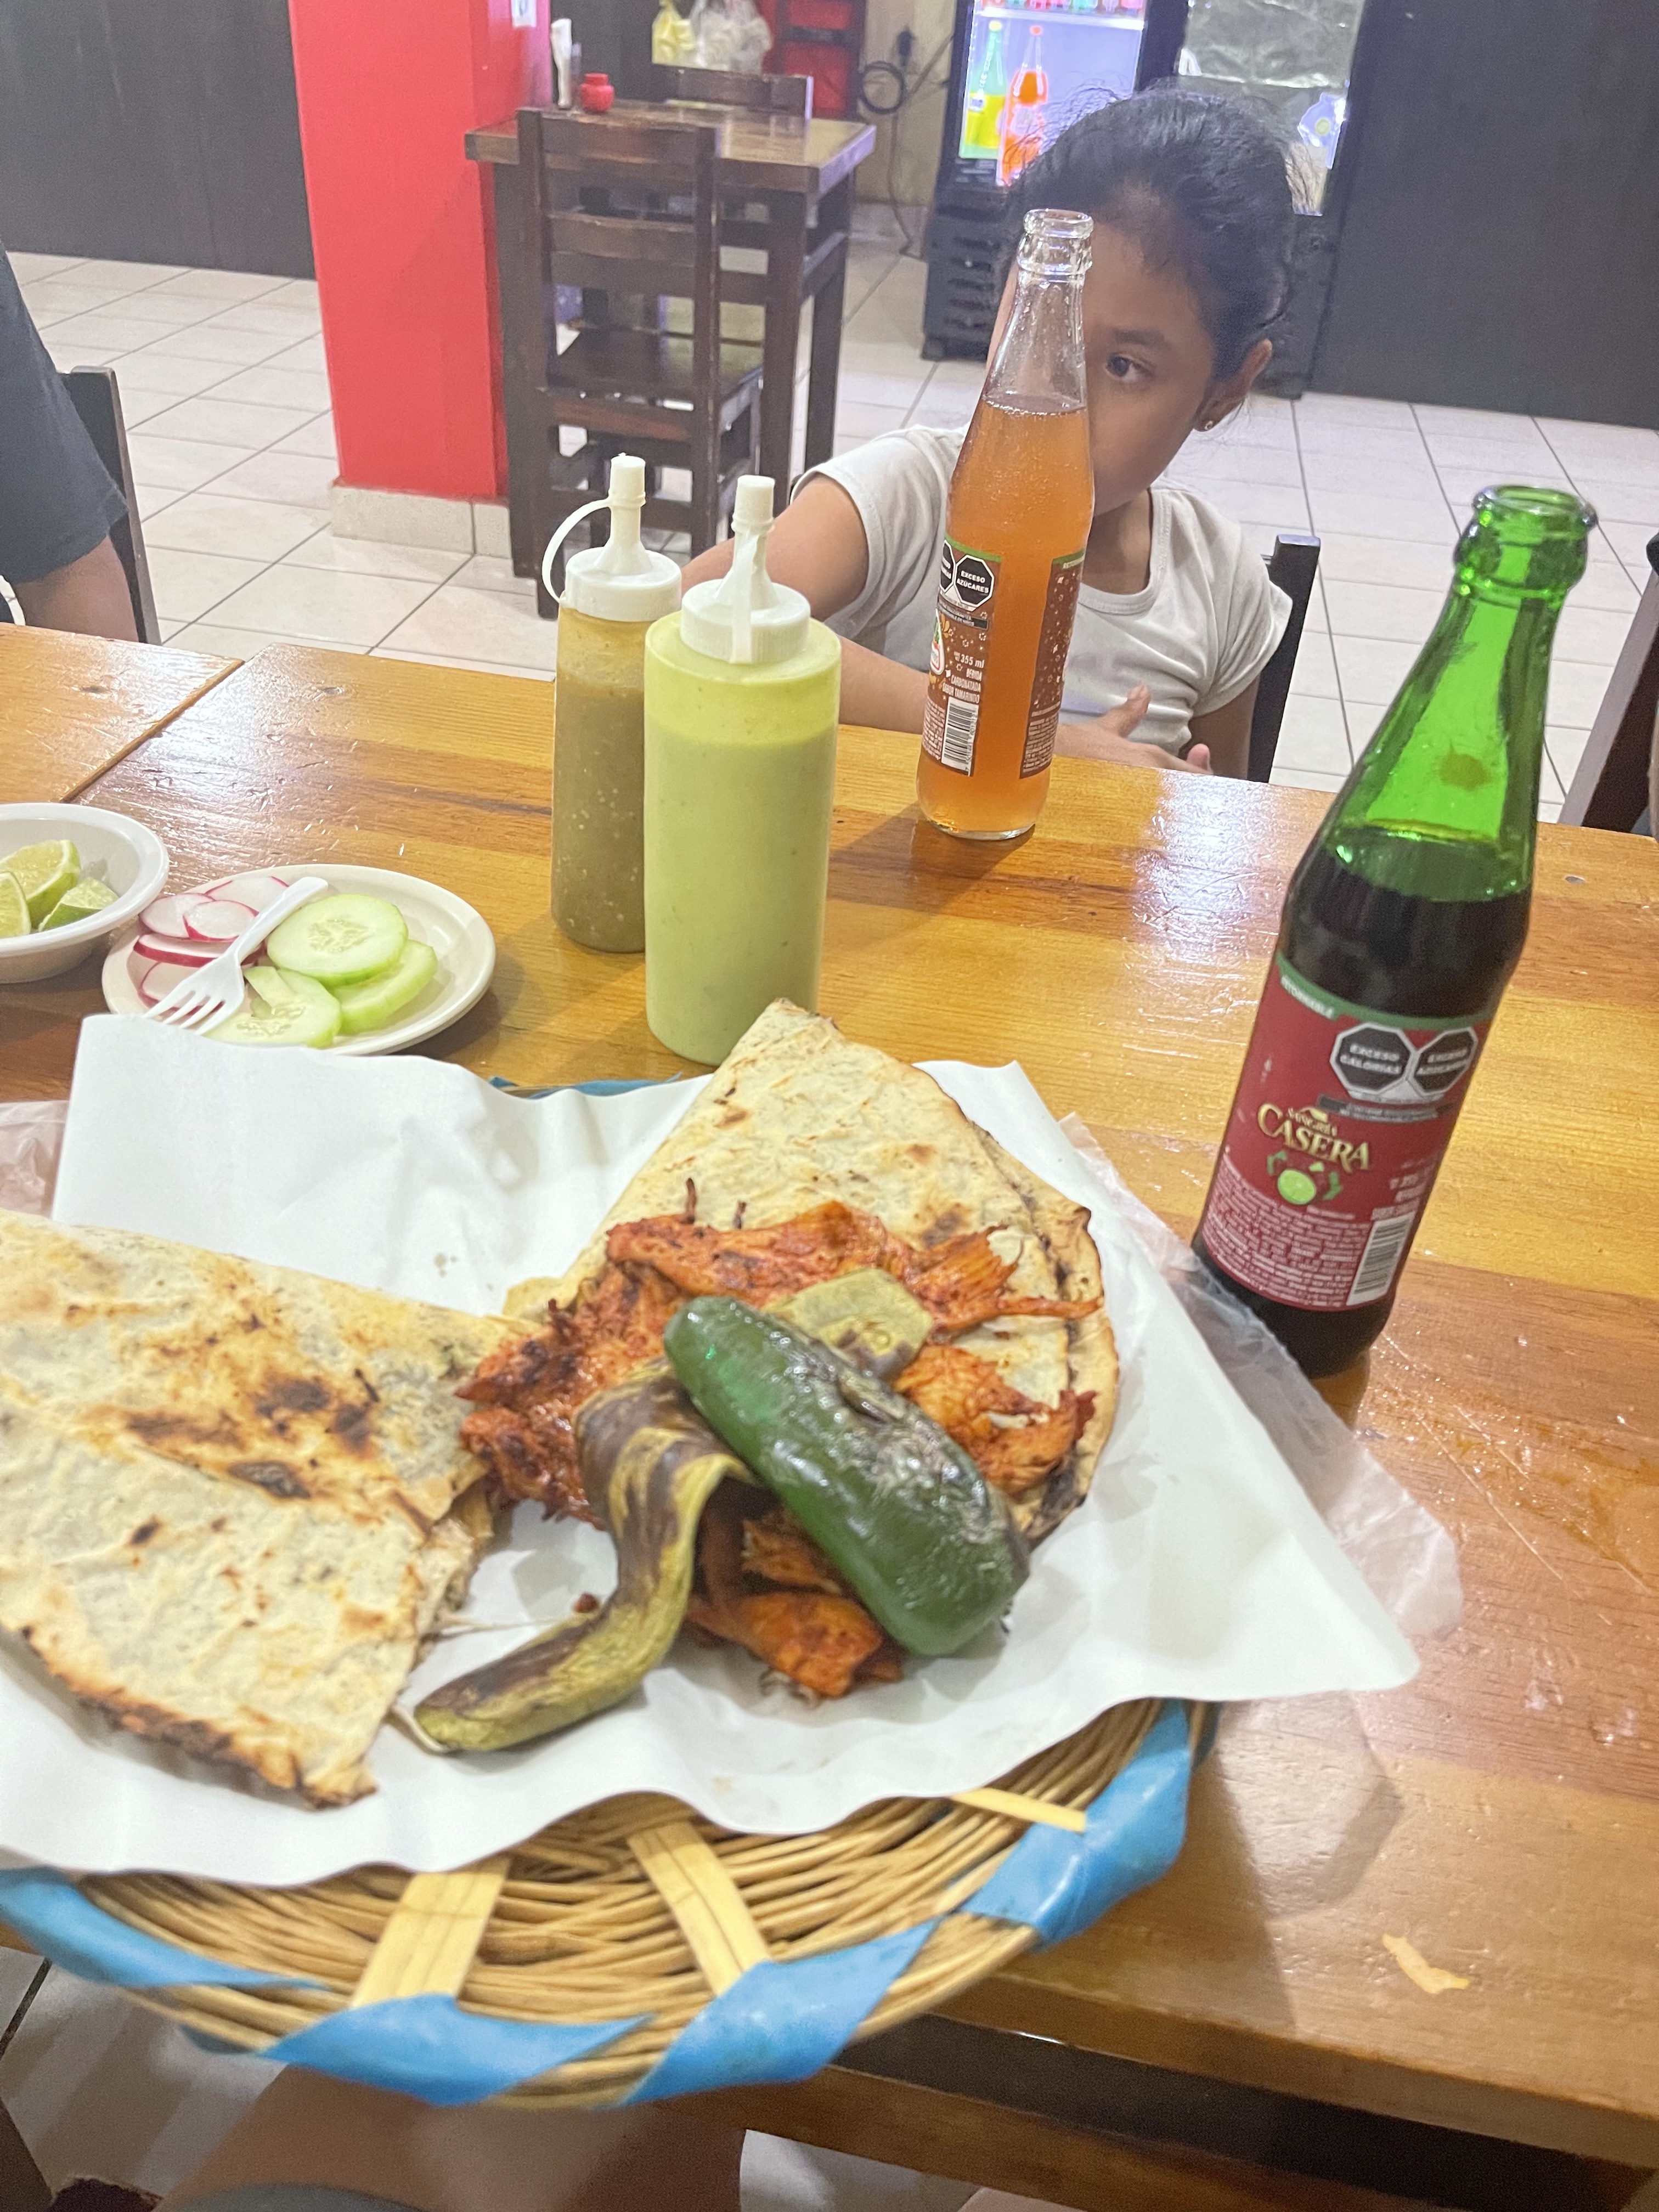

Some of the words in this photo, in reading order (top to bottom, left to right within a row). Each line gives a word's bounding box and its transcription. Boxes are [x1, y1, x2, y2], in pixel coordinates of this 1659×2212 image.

[961, 570, 985, 583] EXCESO
[956, 578, 989, 594] AZÚCARES
[960, 653, 974, 665] 355
[974, 659, 985, 668] ml
[1258, 1103, 1369, 1173] CASERA
